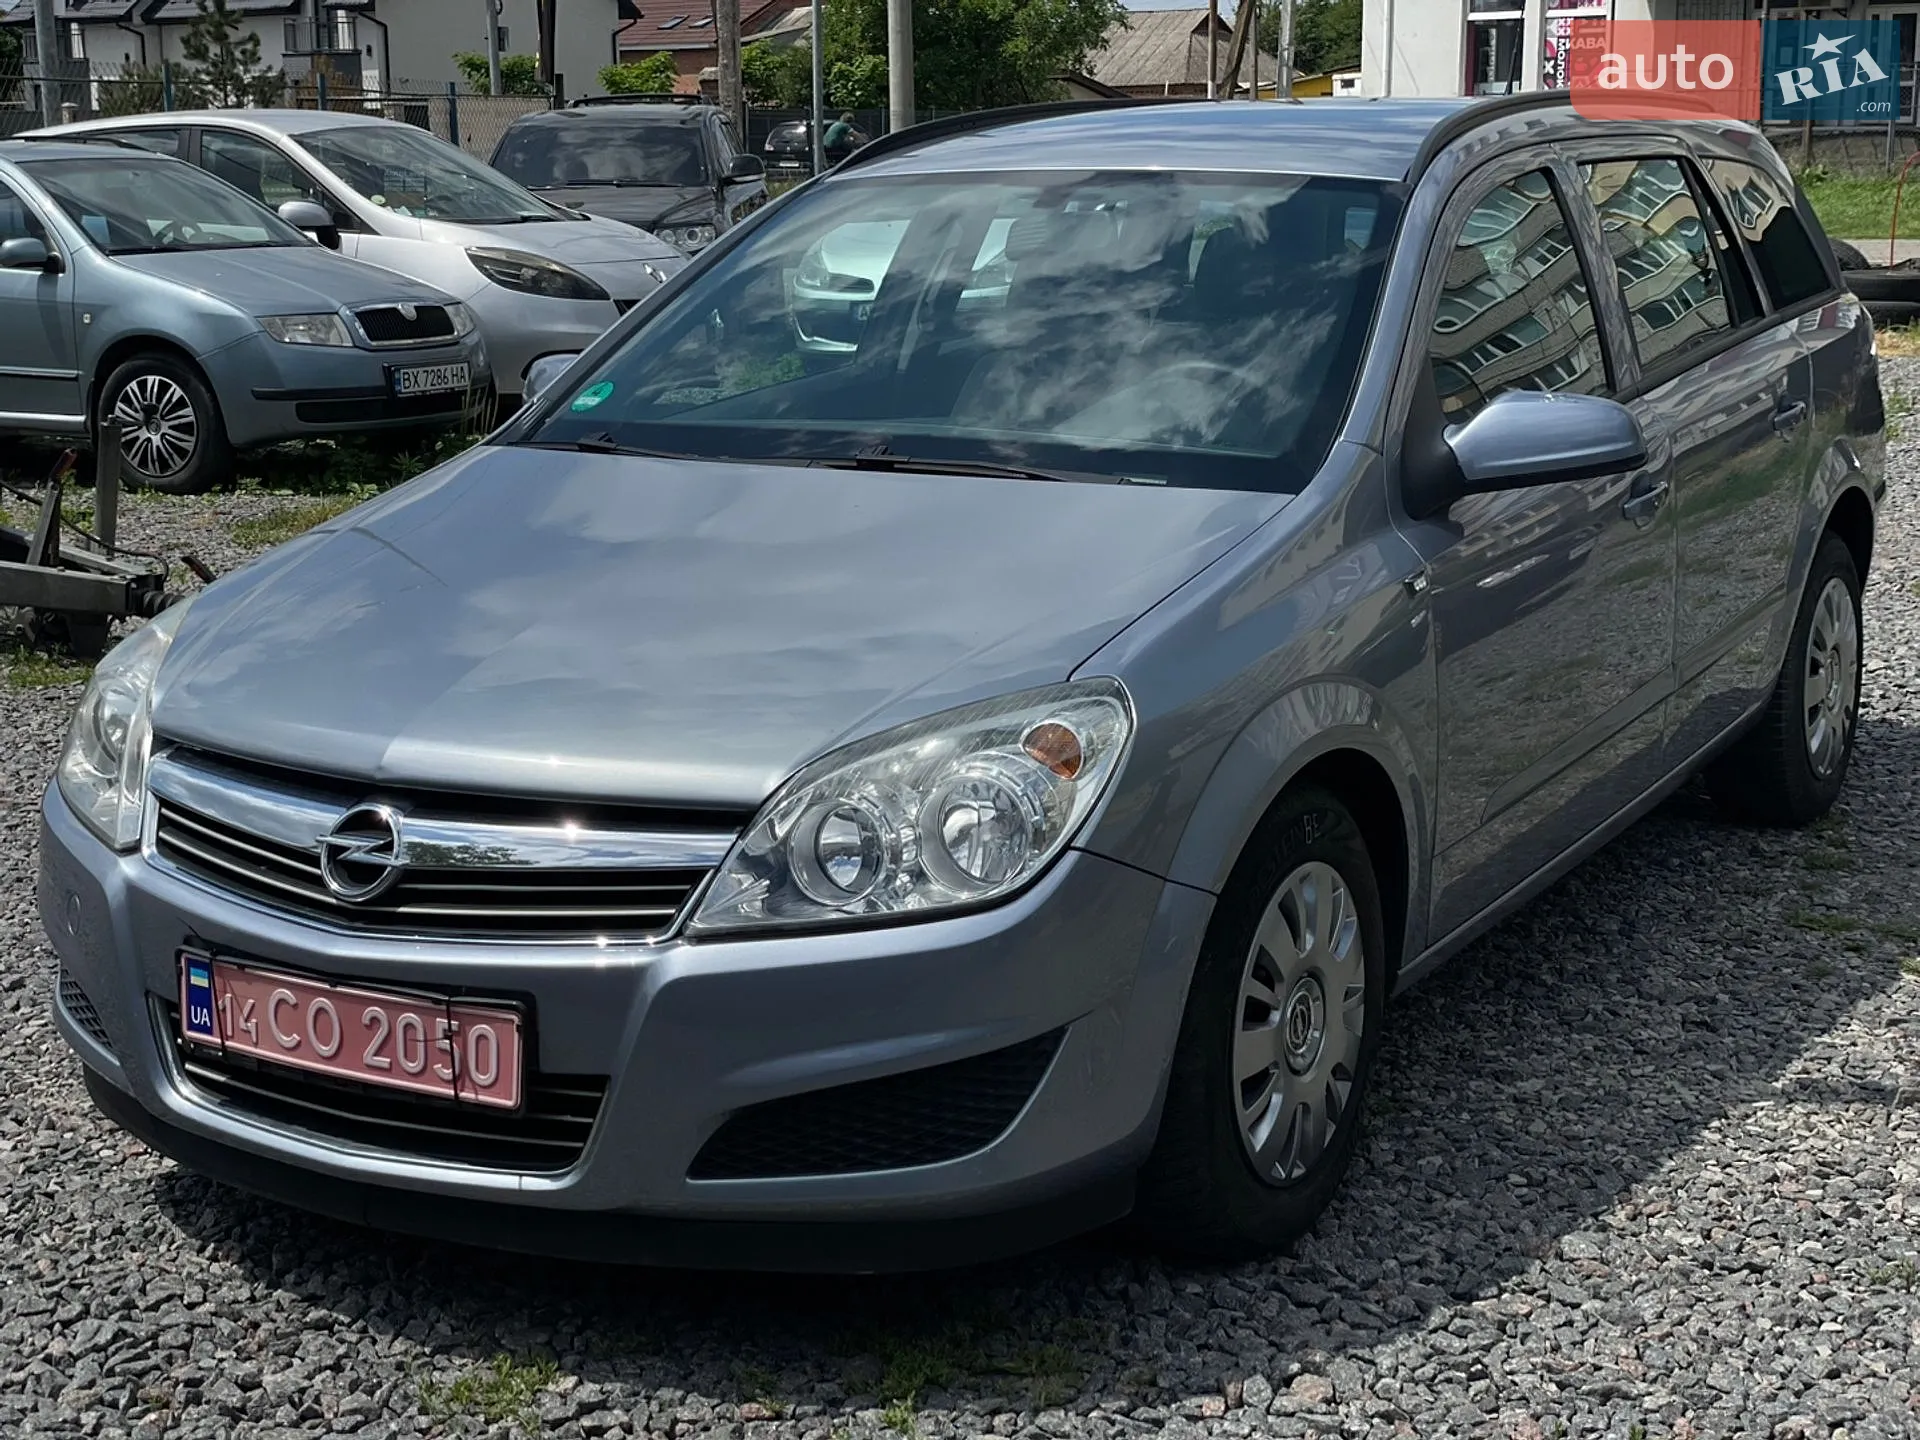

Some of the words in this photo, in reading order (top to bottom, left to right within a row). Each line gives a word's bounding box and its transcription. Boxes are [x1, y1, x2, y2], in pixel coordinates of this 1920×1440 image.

[403, 371, 420, 389] BX
[423, 368, 449, 387] 7286
[451, 366, 466, 384] HA
[191, 1005, 210, 1027] UA
[218, 994, 258, 1044] 14
[268, 988, 341, 1059] CO
[362, 1006, 499, 1088] 2050
